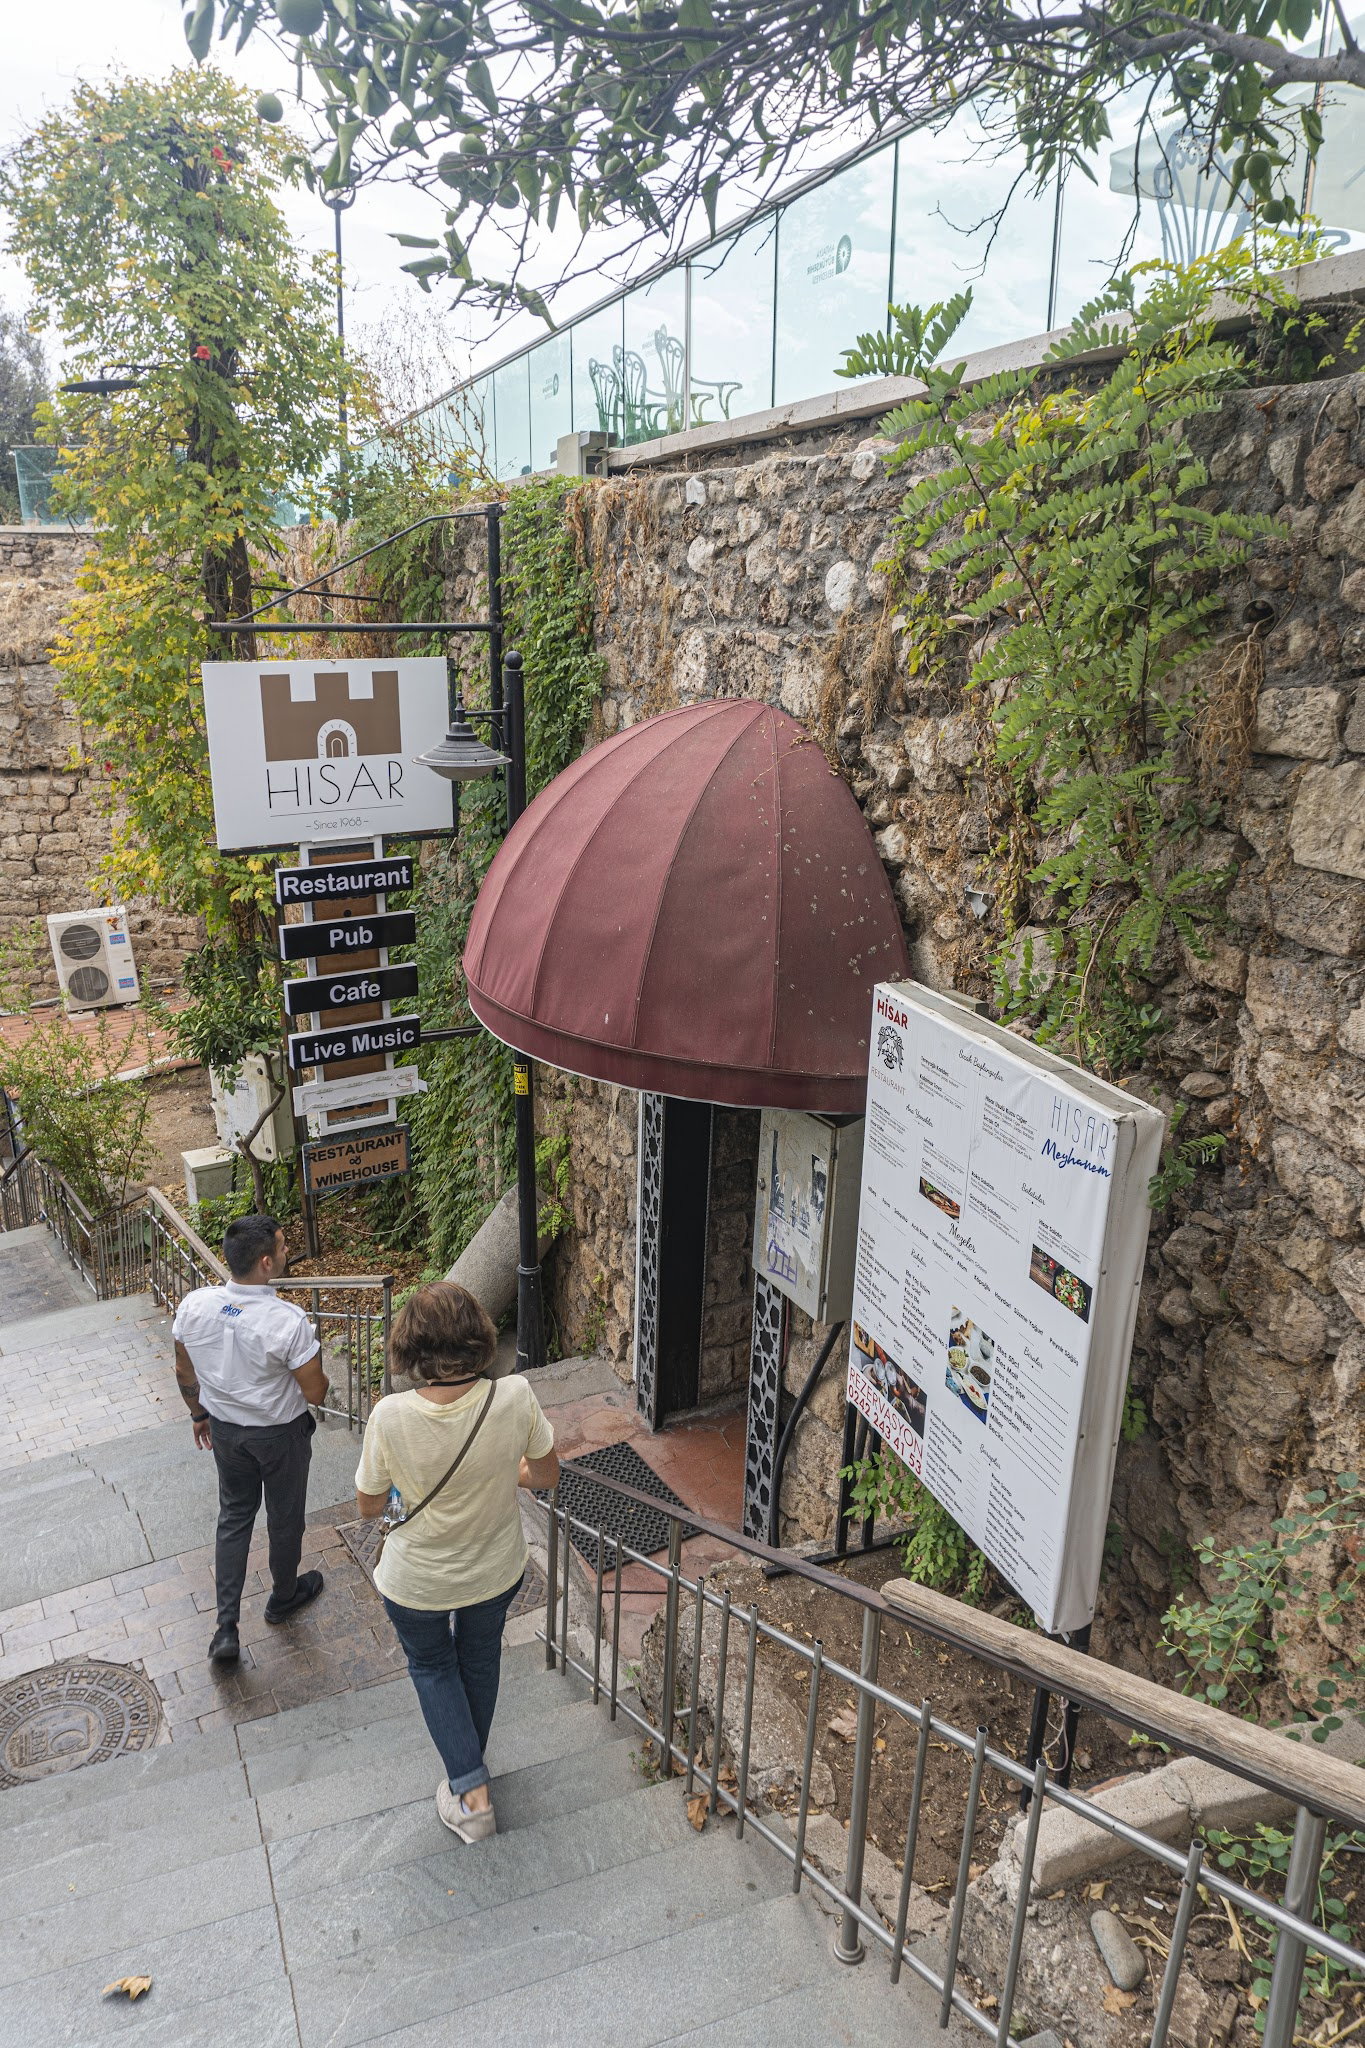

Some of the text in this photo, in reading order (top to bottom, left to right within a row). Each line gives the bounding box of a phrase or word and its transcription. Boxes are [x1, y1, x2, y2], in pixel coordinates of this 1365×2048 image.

[266, 760, 404, 809] HISAR
[313, 816, 363, 830] Since 1968
[283, 865, 411, 897] Restaurant
[329, 925, 374, 949] Pub
[329, 980, 381, 1004] Cafe
[877, 998, 908, 1030] HİSAR
[300, 1027, 415, 1063] Live Music
[871, 1066, 906, 1096] RESTAURANT
[308, 1133, 404, 1163] RESTAURANT
[1041, 1138, 1111, 1178] Meyhanem
[315, 1159, 399, 1188] WİNEHOUSE
[949, 1223, 976, 1254] Mezeler
[1023, 1346, 1043, 1369] Biralar
[850, 1367, 923, 1459] REZERVASYON
[990, 1412, 1003, 1429] Miller
[991, 1402, 1020, 1433] Amsterdam
[848, 1384, 921, 1475] 0242 243 41 53
[989, 1423, 1003, 1442] Becks
